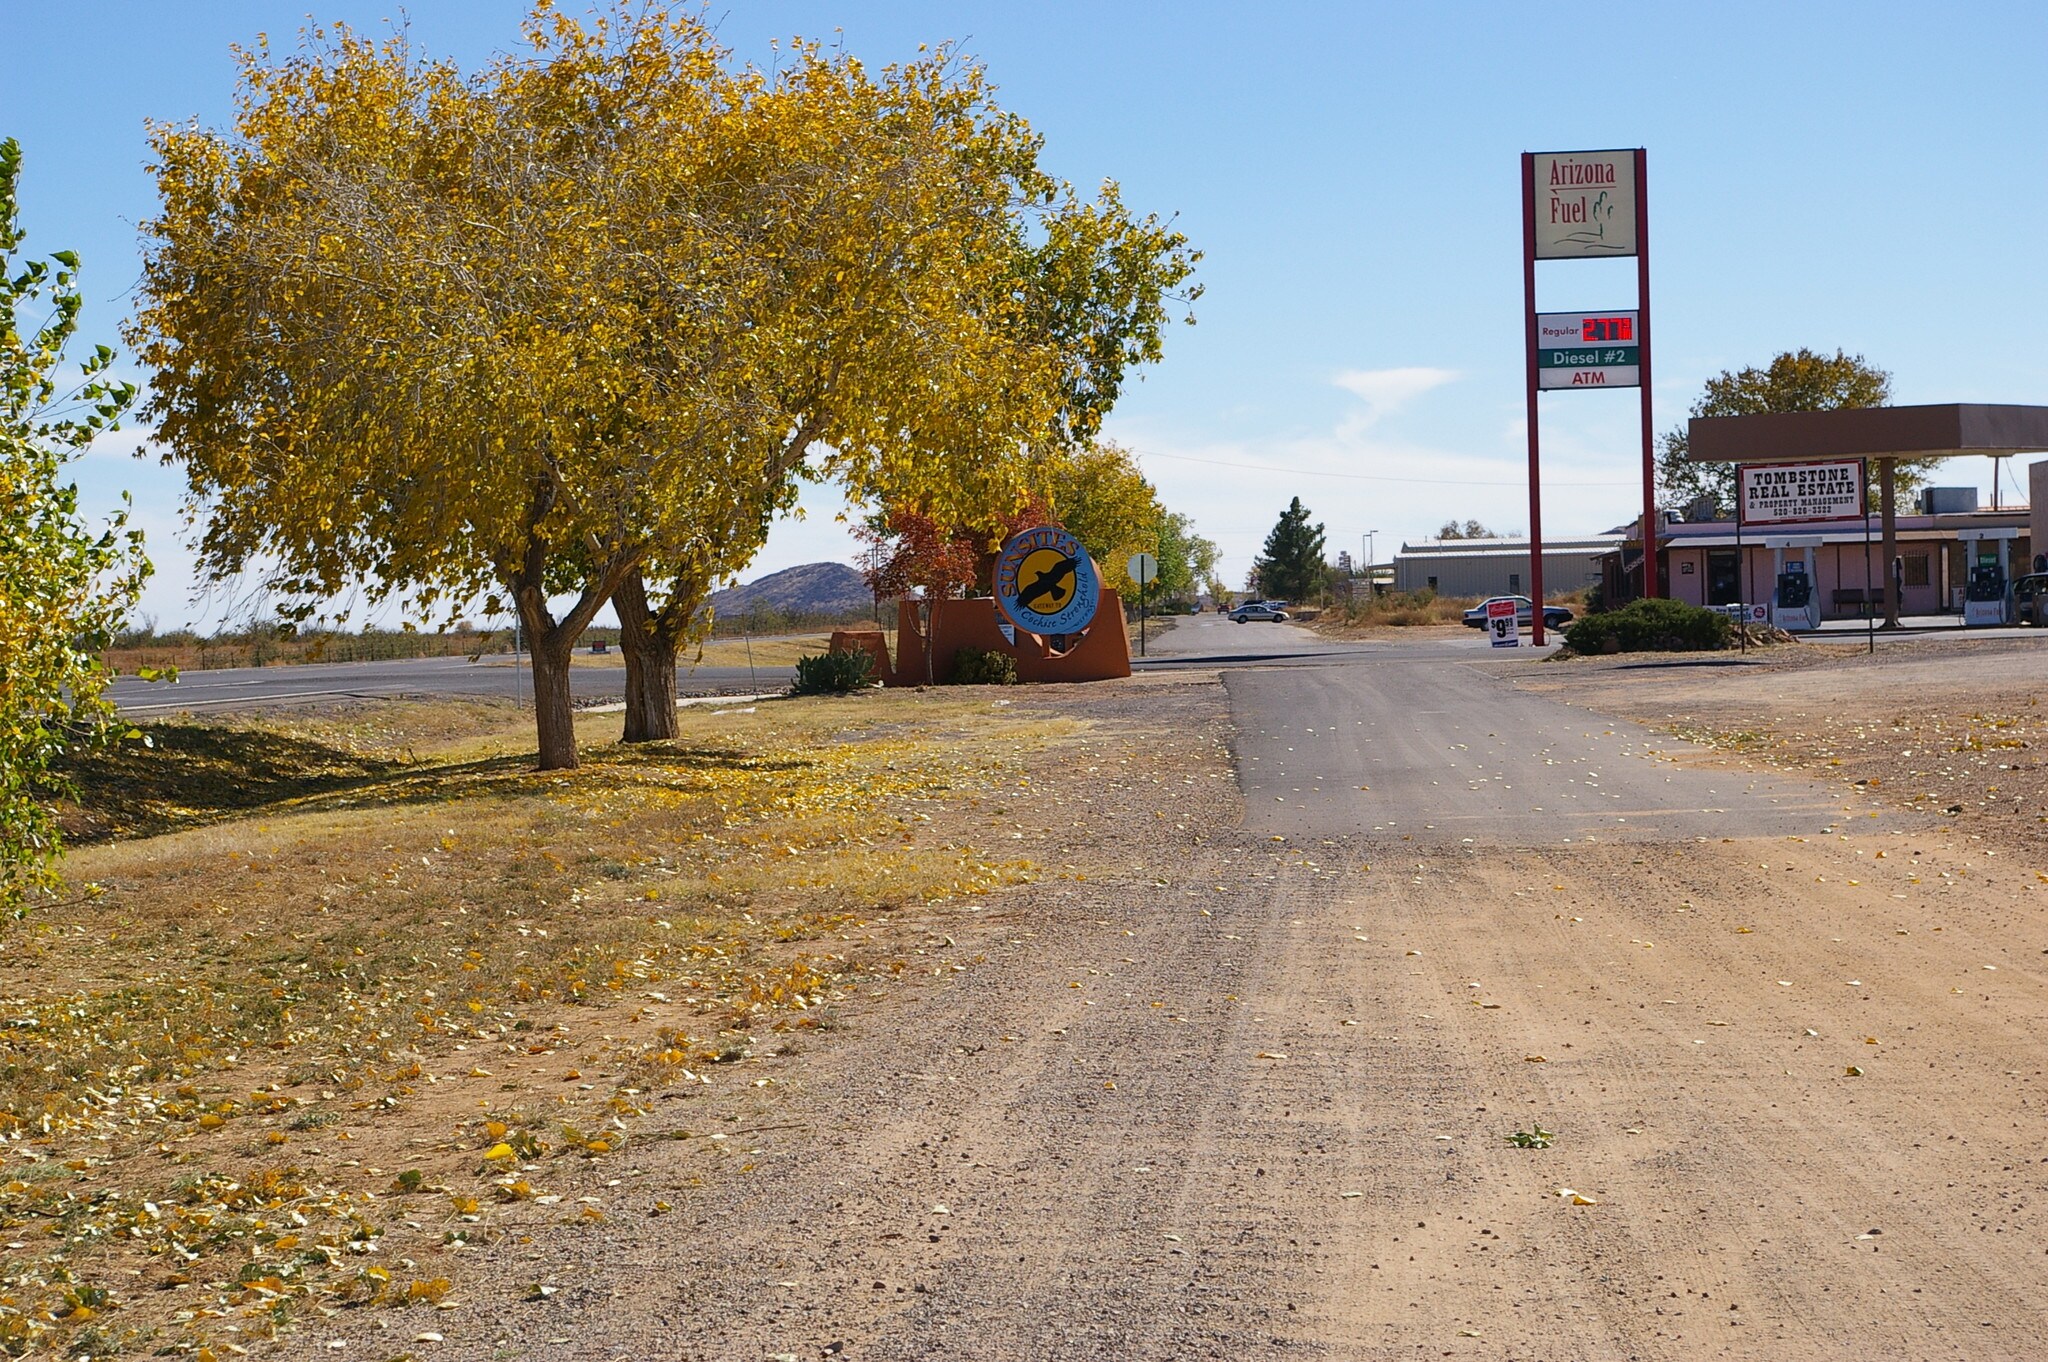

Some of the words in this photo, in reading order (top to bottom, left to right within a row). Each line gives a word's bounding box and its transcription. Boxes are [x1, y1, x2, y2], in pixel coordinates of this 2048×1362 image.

[1549, 159, 1615, 186] Arizona
[1550, 196, 1587, 223] Fuel
[1542, 327, 1579, 337] Regular
[1553, 350, 1599, 365] Diesel
[1604, 350, 1625, 363] #2
[1572, 371, 1605, 384] ATM
[1754, 468, 1849, 485] TOMBSTONE
[1749, 486, 1790, 499] REAL
[1798, 481, 1855, 496] ESTATE
[1759, 499, 1798, 509] PROPERTY
[1801, 496, 1855, 506] MANAGEMENT
[1773, 506, 1832, 516] 520-826-3322
[1001, 531, 1080, 598] SUNSITES
[1021, 611, 1058, 628] Cochise
[1060, 571, 1090, 625] Stronghold
